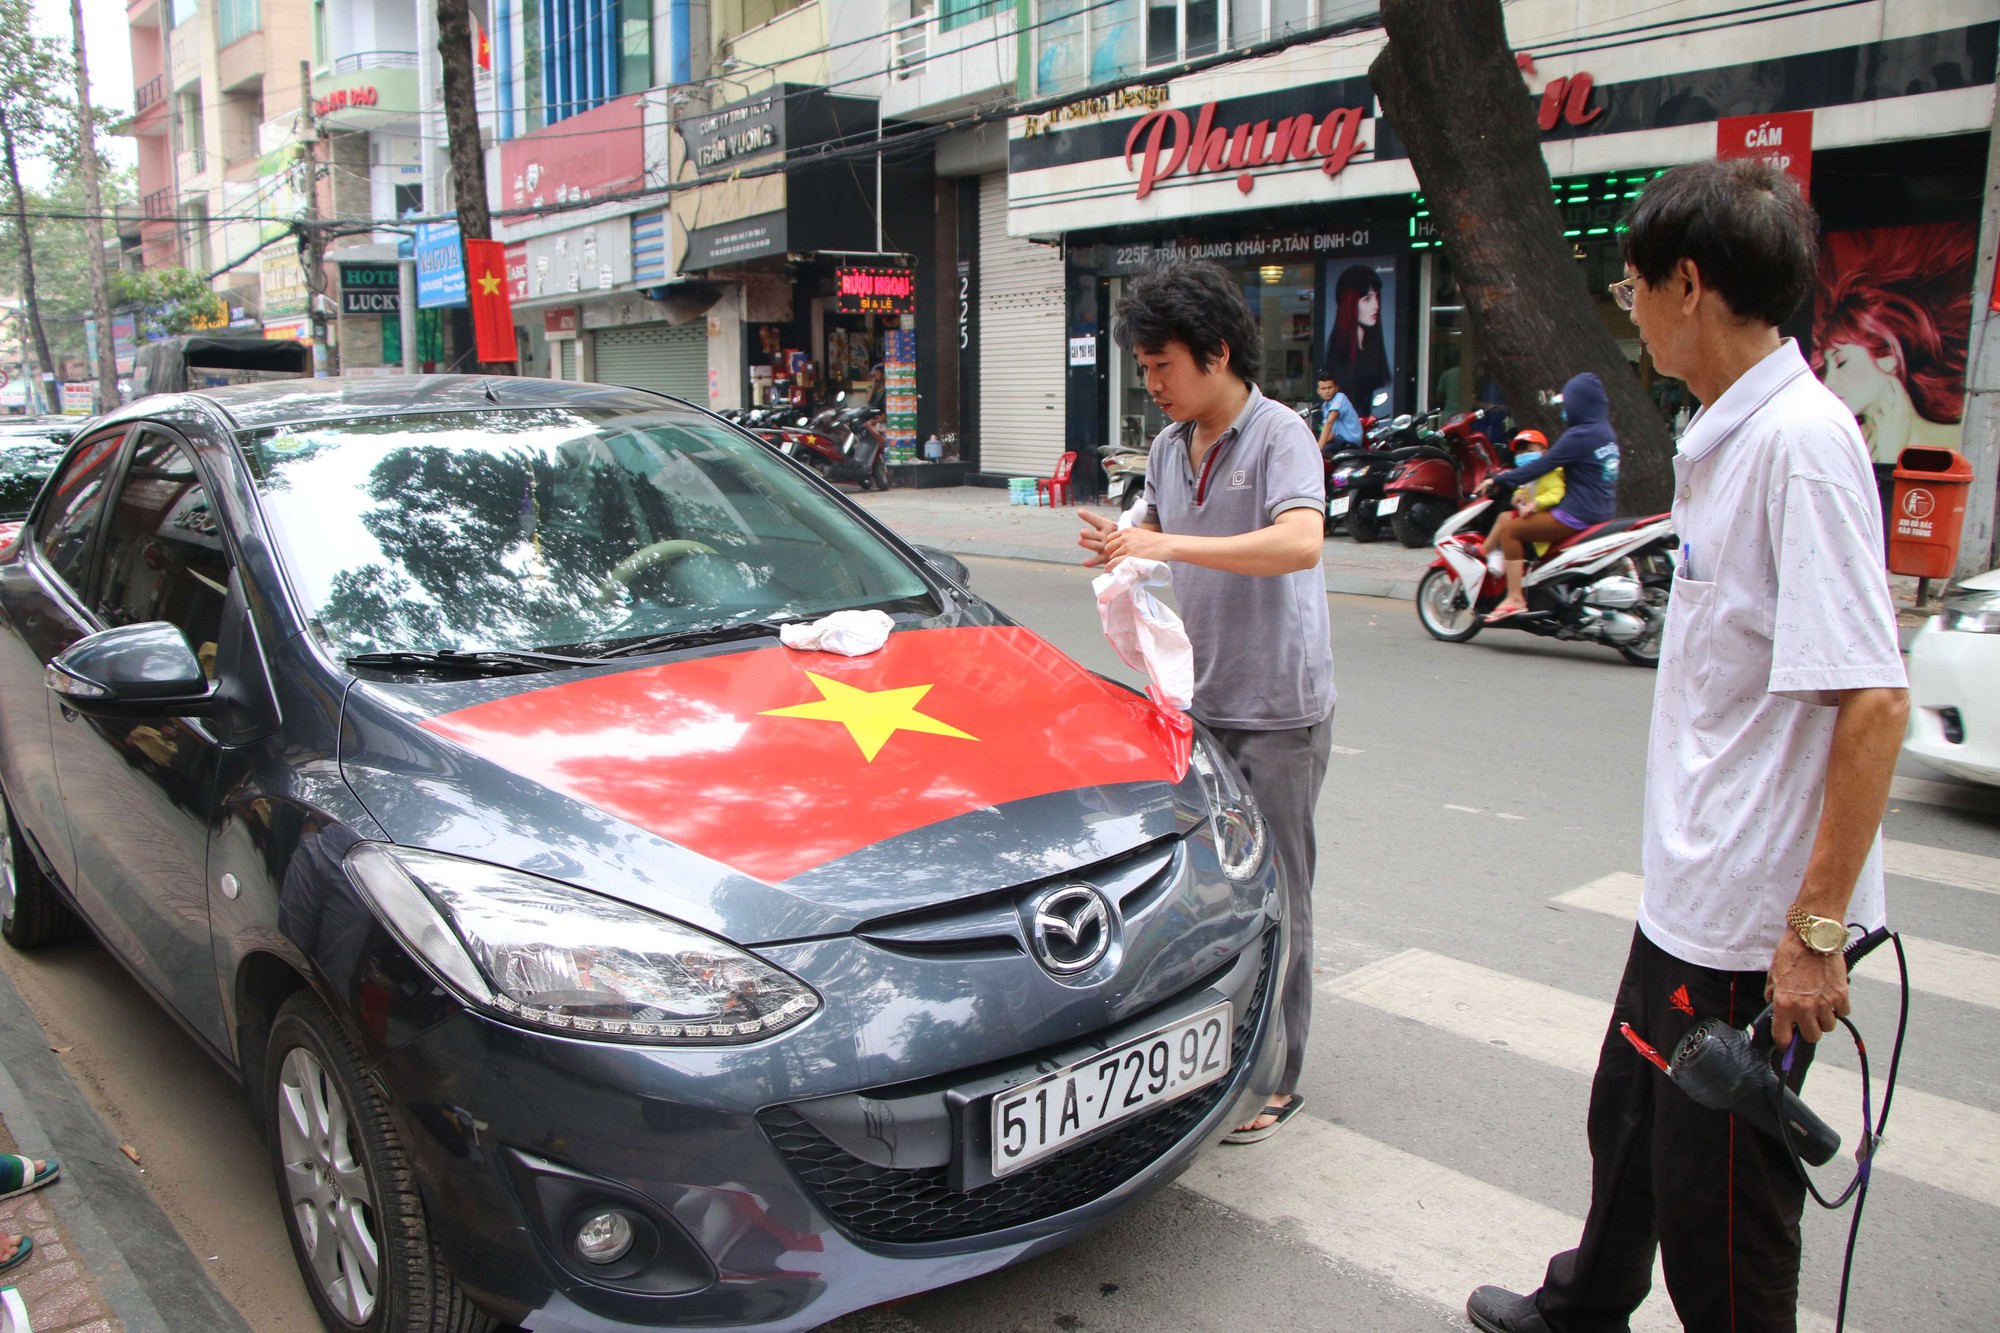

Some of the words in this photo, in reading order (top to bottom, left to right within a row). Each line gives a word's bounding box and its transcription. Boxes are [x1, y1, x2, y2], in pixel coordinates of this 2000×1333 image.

[1745, 121, 1783, 148] CẤM
[1125, 101, 1367, 200] Phụng
[420, 243, 460, 274] NAGOYA
[1117, 246, 1150, 265] 225F
[1155, 242, 1186, 263] TRẦN
[1190, 242, 1232, 258] QUANG
[346, 270, 400, 285] HOTE
[560, 316, 575, 329] ATM
[1003, 1018, 1222, 1157] 51A-729.92
